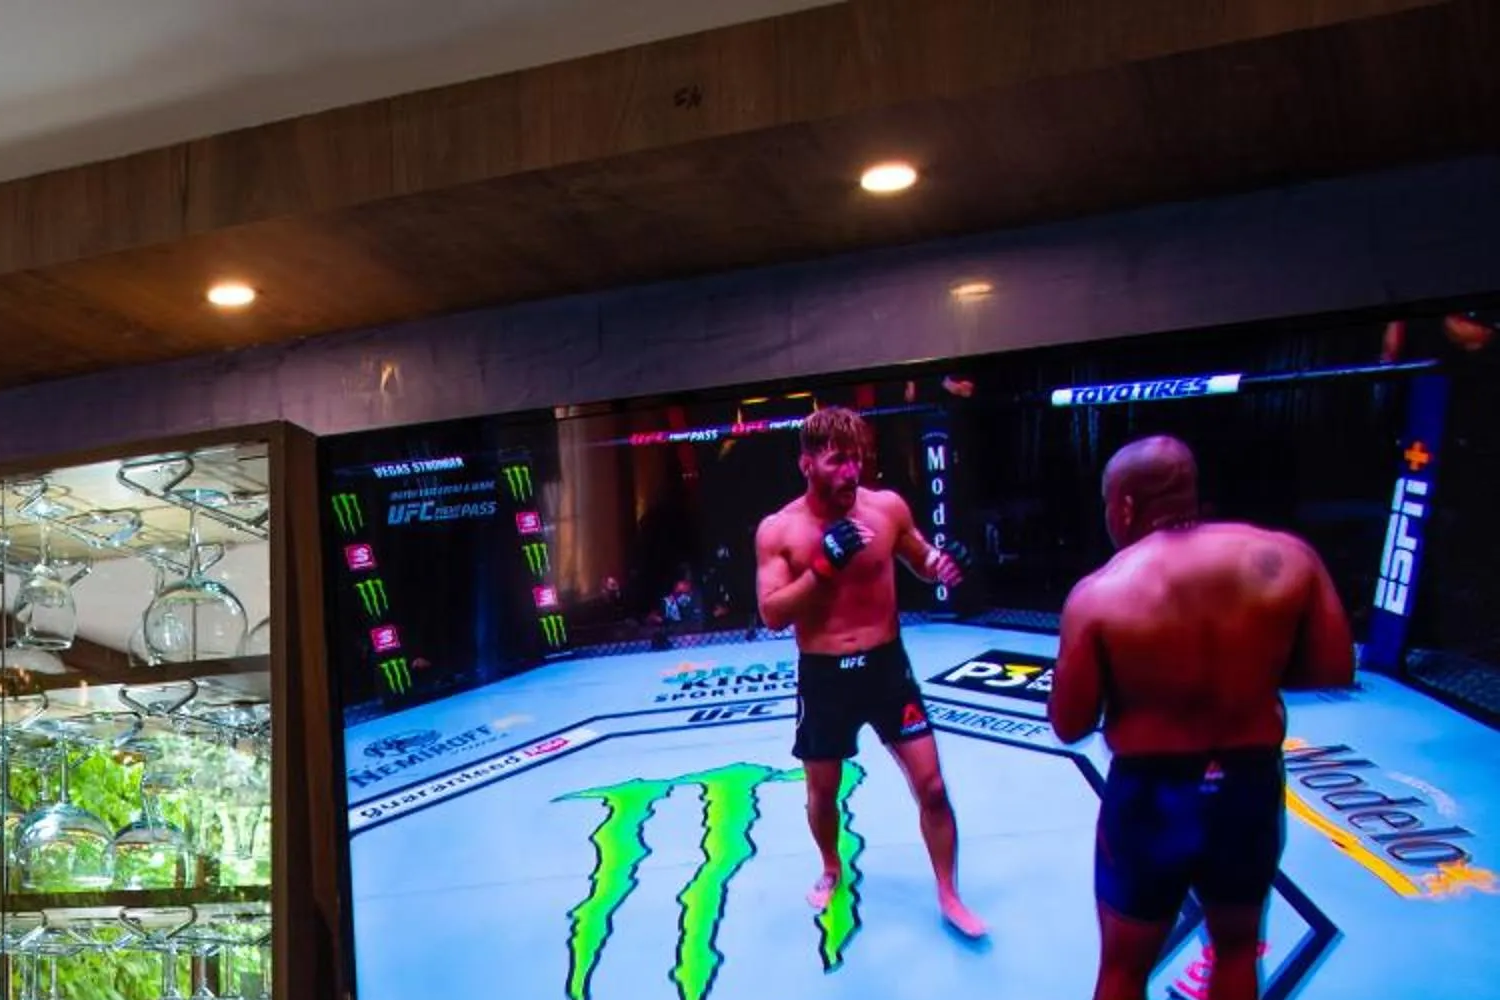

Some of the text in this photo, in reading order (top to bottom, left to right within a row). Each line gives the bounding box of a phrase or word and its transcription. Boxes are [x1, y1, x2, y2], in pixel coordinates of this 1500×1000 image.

[373, 462, 411, 479] VEGAS
[387, 501, 436, 525] UFC
[461, 501, 498, 518] PASS
[927, 445, 947, 601] Modeo
[840, 655, 866, 669] UFC
[681, 670, 797, 690] KING
[654, 682, 798, 702] SPORTSBO
[687, 702, 779, 722] UFC
[927, 702, 1050, 737] EMIROFF
[1283, 743, 1476, 867] Modelo
